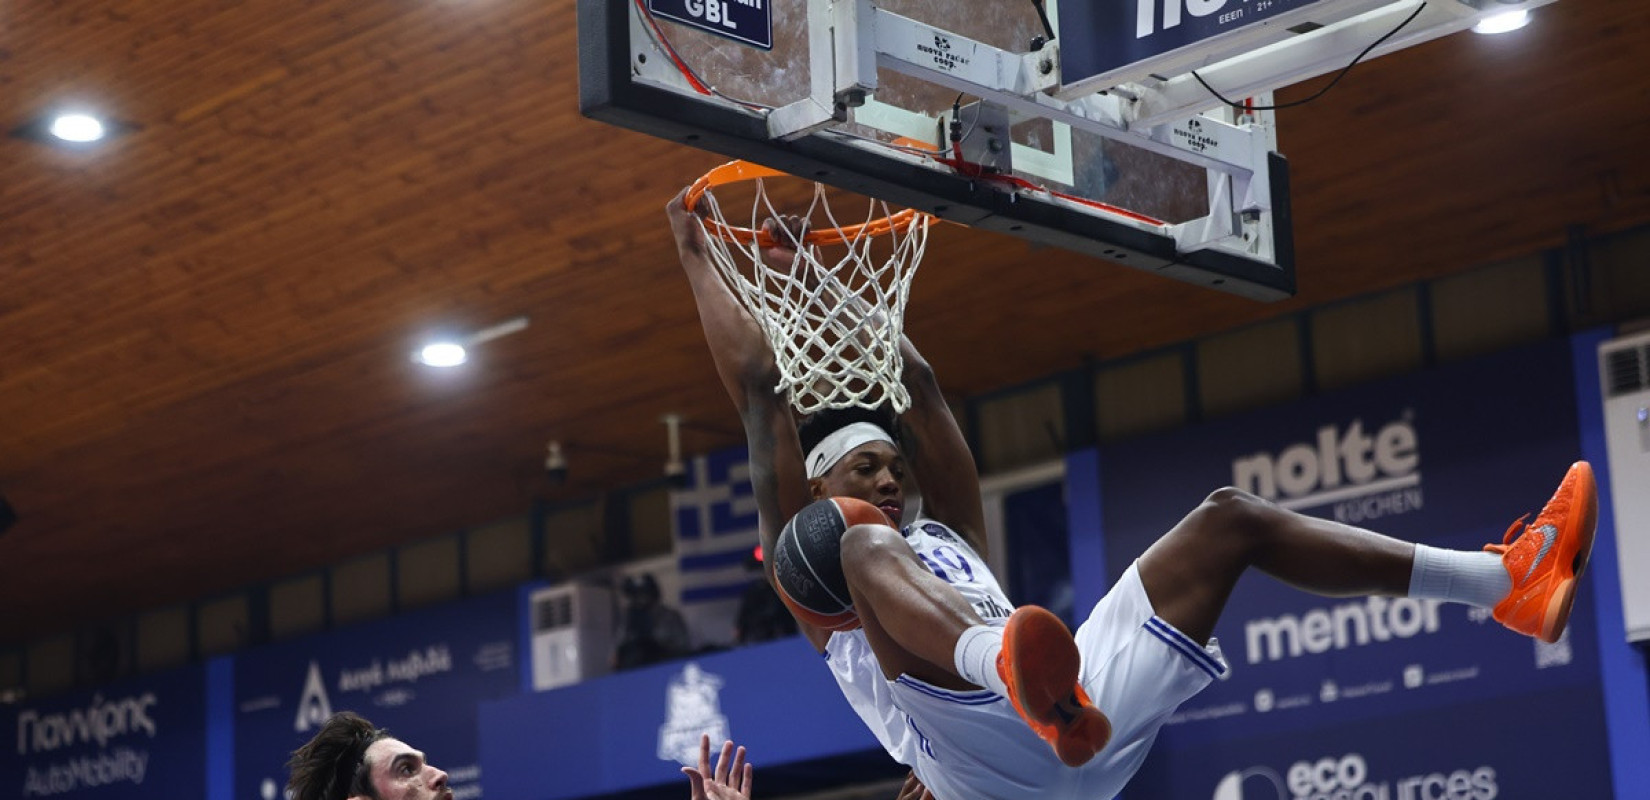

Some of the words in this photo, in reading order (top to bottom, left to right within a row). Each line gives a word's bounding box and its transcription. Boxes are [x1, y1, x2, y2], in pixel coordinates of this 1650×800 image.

[684, 0, 737, 29] GBL
[1233, 418, 1419, 499] nolte
[1245, 596, 1441, 664] mentor
[1286, 753, 1366, 797] eco
